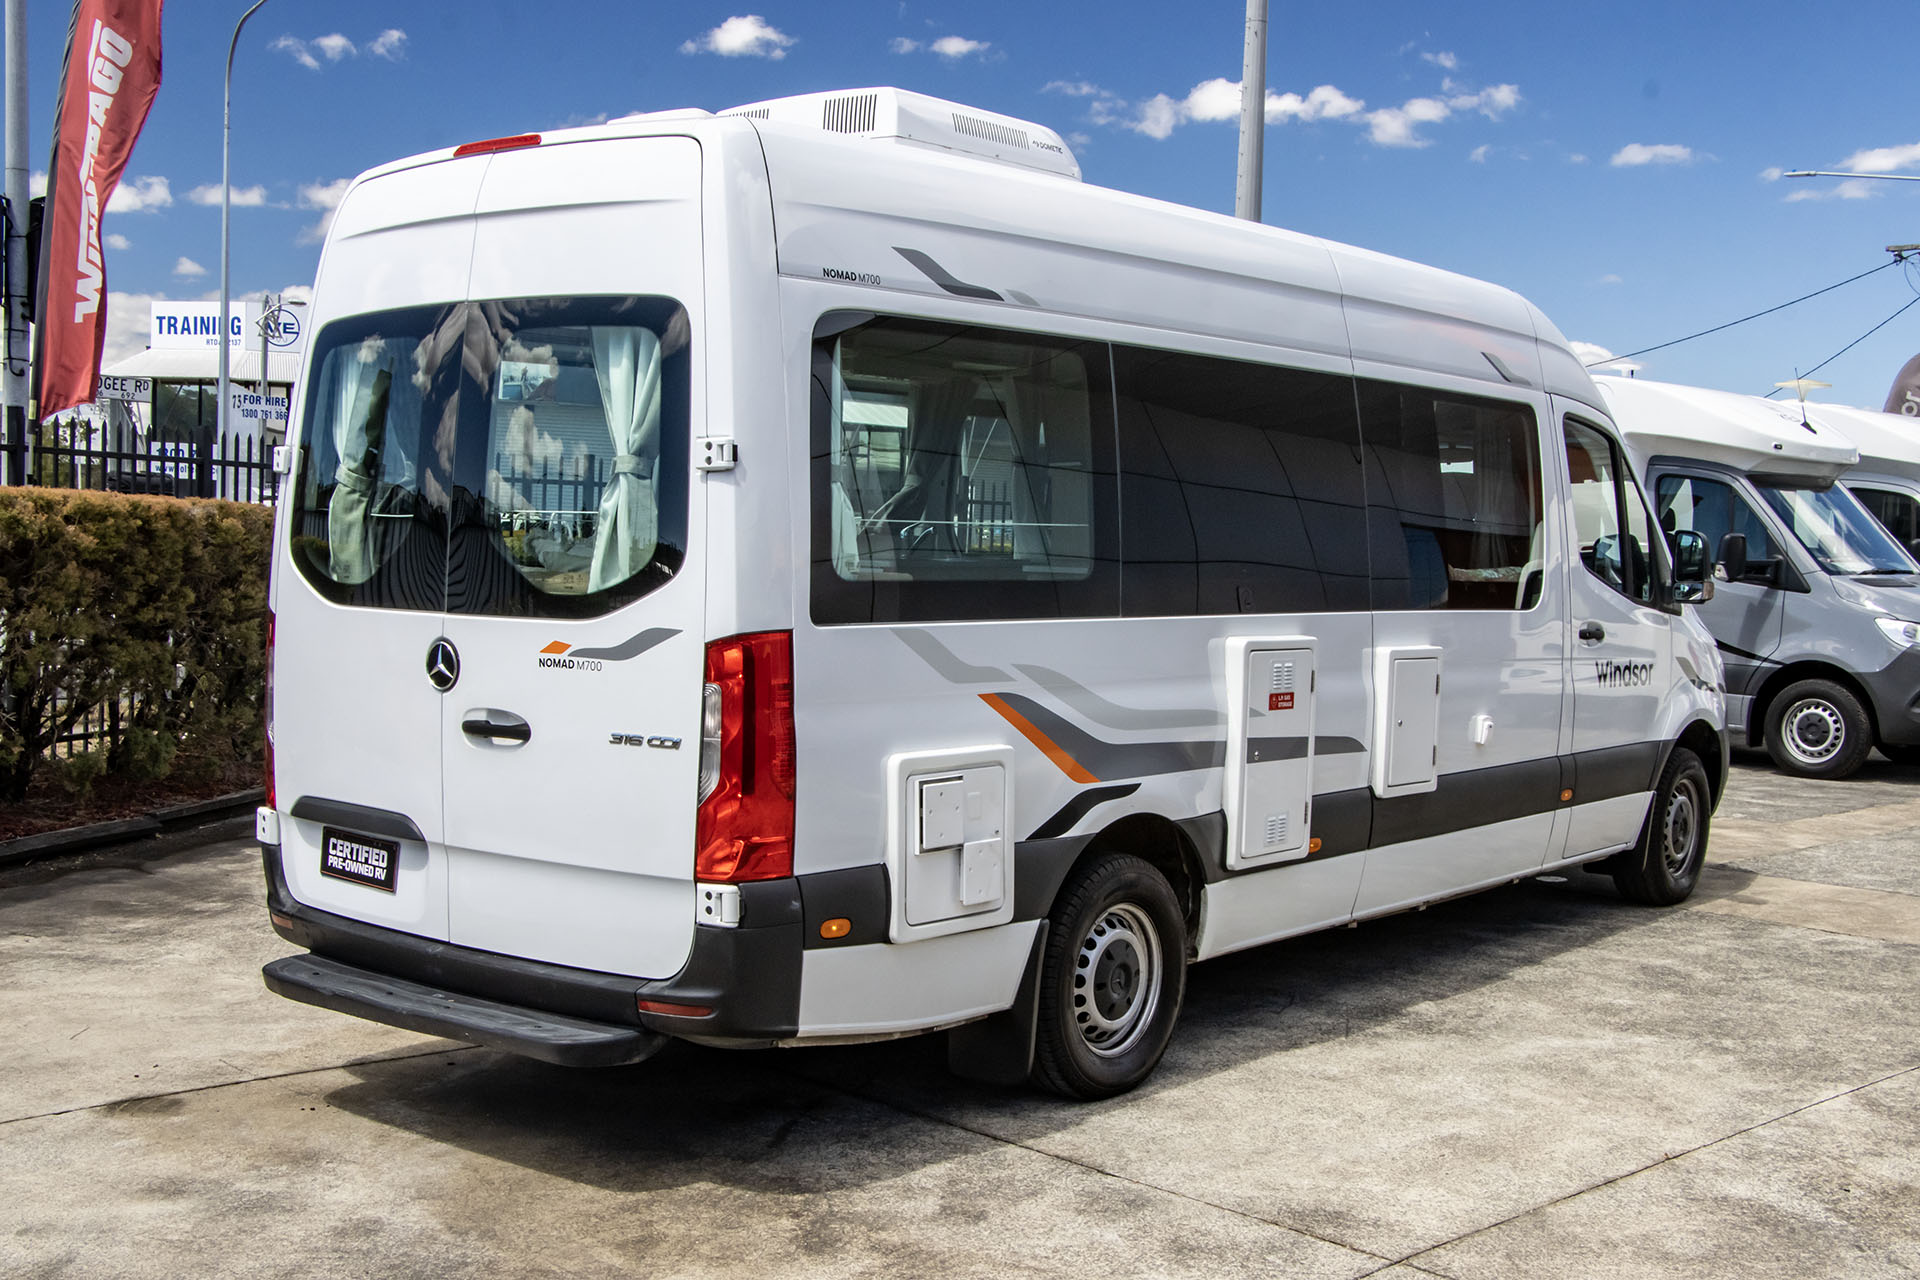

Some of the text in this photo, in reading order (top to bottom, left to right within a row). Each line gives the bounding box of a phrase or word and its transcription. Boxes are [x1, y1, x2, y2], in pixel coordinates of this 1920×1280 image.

[822, 267, 881, 285] NOMAD M700
[156, 316, 242, 335] TRAINIG
[134, 380, 149, 393] RD
[121, 391, 136, 400] 692
[243, 394, 286, 407] FOR HIRE
[241, 408, 258, 419] 1300
[260, 409, 272, 420] 761
[538, 658, 603, 671] NOMAD M700
[1595, 660, 1654, 688] Windsor
[609, 733, 682, 750] 316 CDI
[328, 837, 388, 868] CERTIFIED
[328, 855, 387, 880] PRE-OWNED RV
